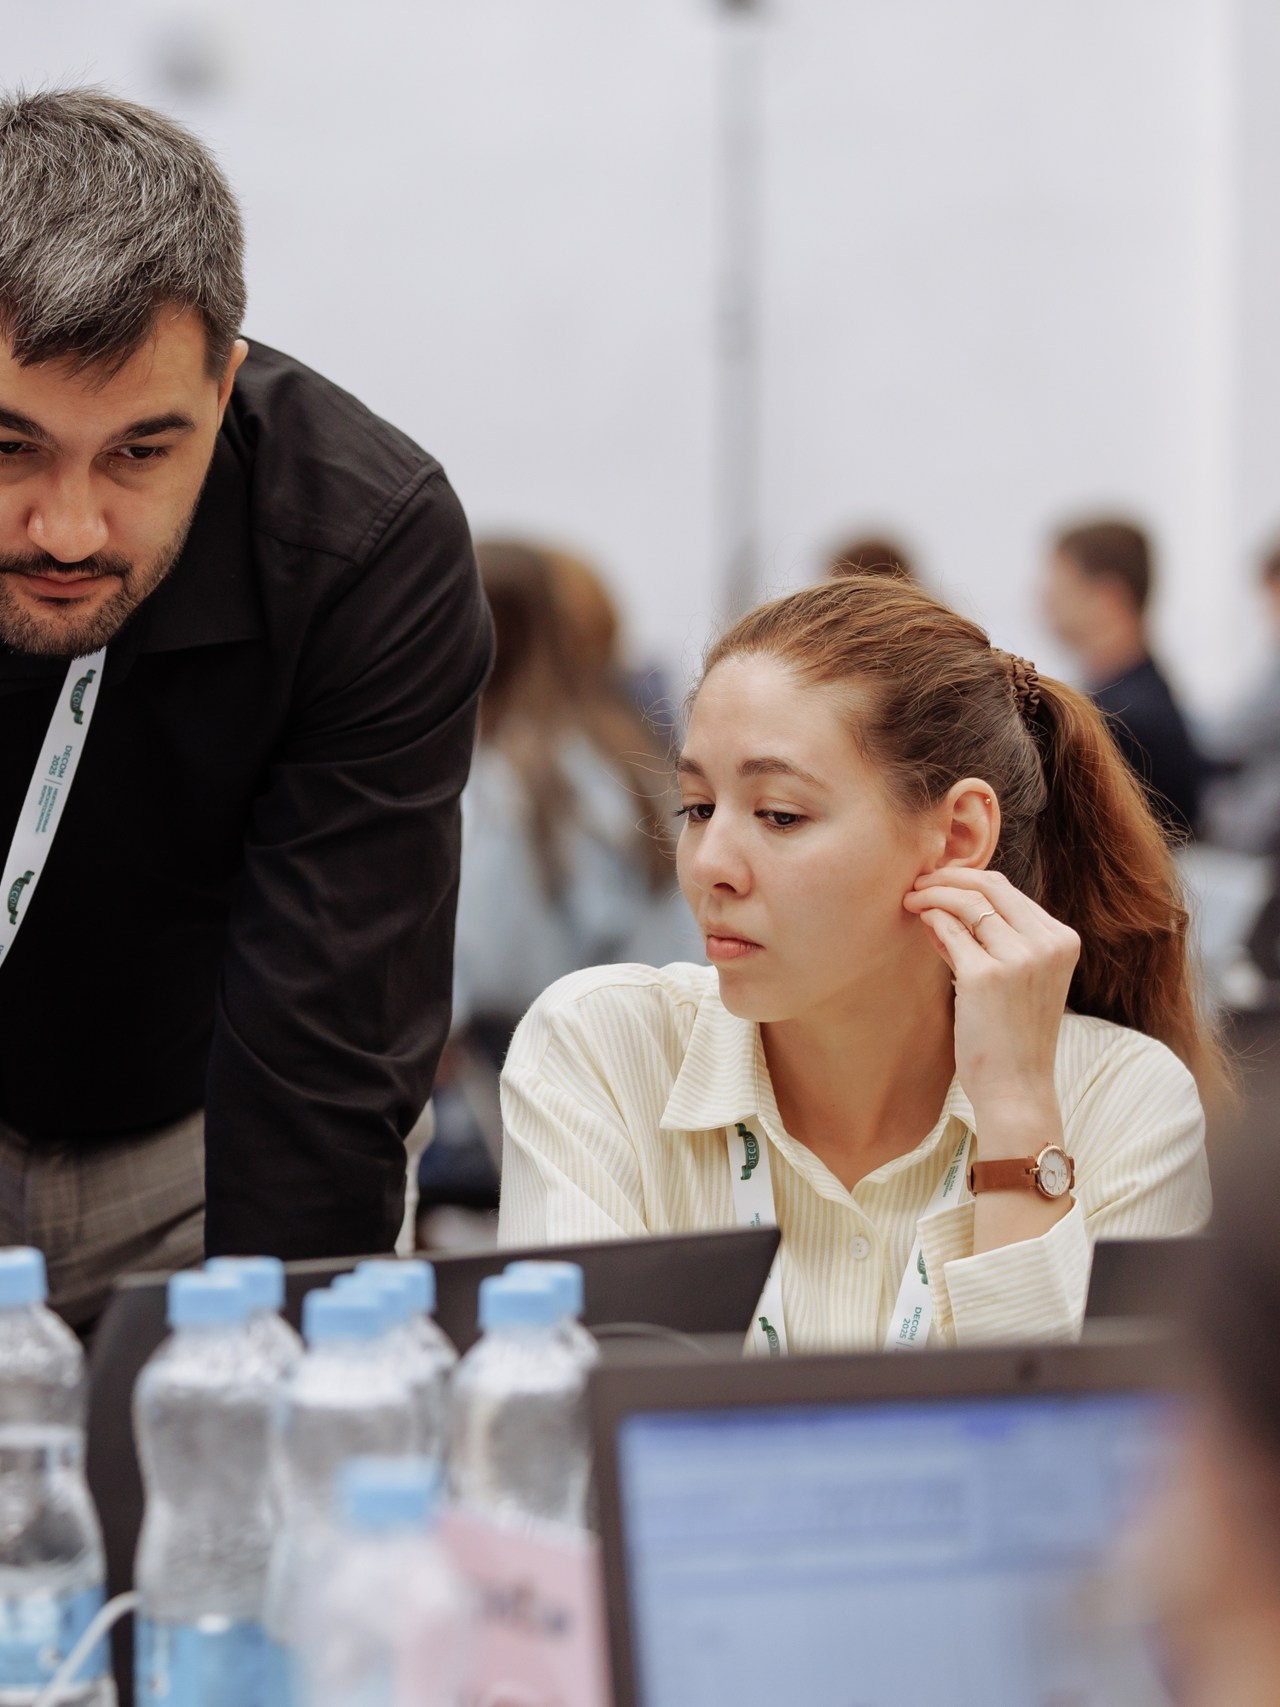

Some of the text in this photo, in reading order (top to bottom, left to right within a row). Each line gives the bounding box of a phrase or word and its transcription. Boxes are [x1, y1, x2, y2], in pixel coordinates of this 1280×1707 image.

[48, 754, 61, 776] 2025
[57, 745, 72, 778] DECOM
[745, 1133, 757, 1167] DECOM
[899, 1318, 911, 1340] 2025
[907, 1306, 923, 1342] DECOM
